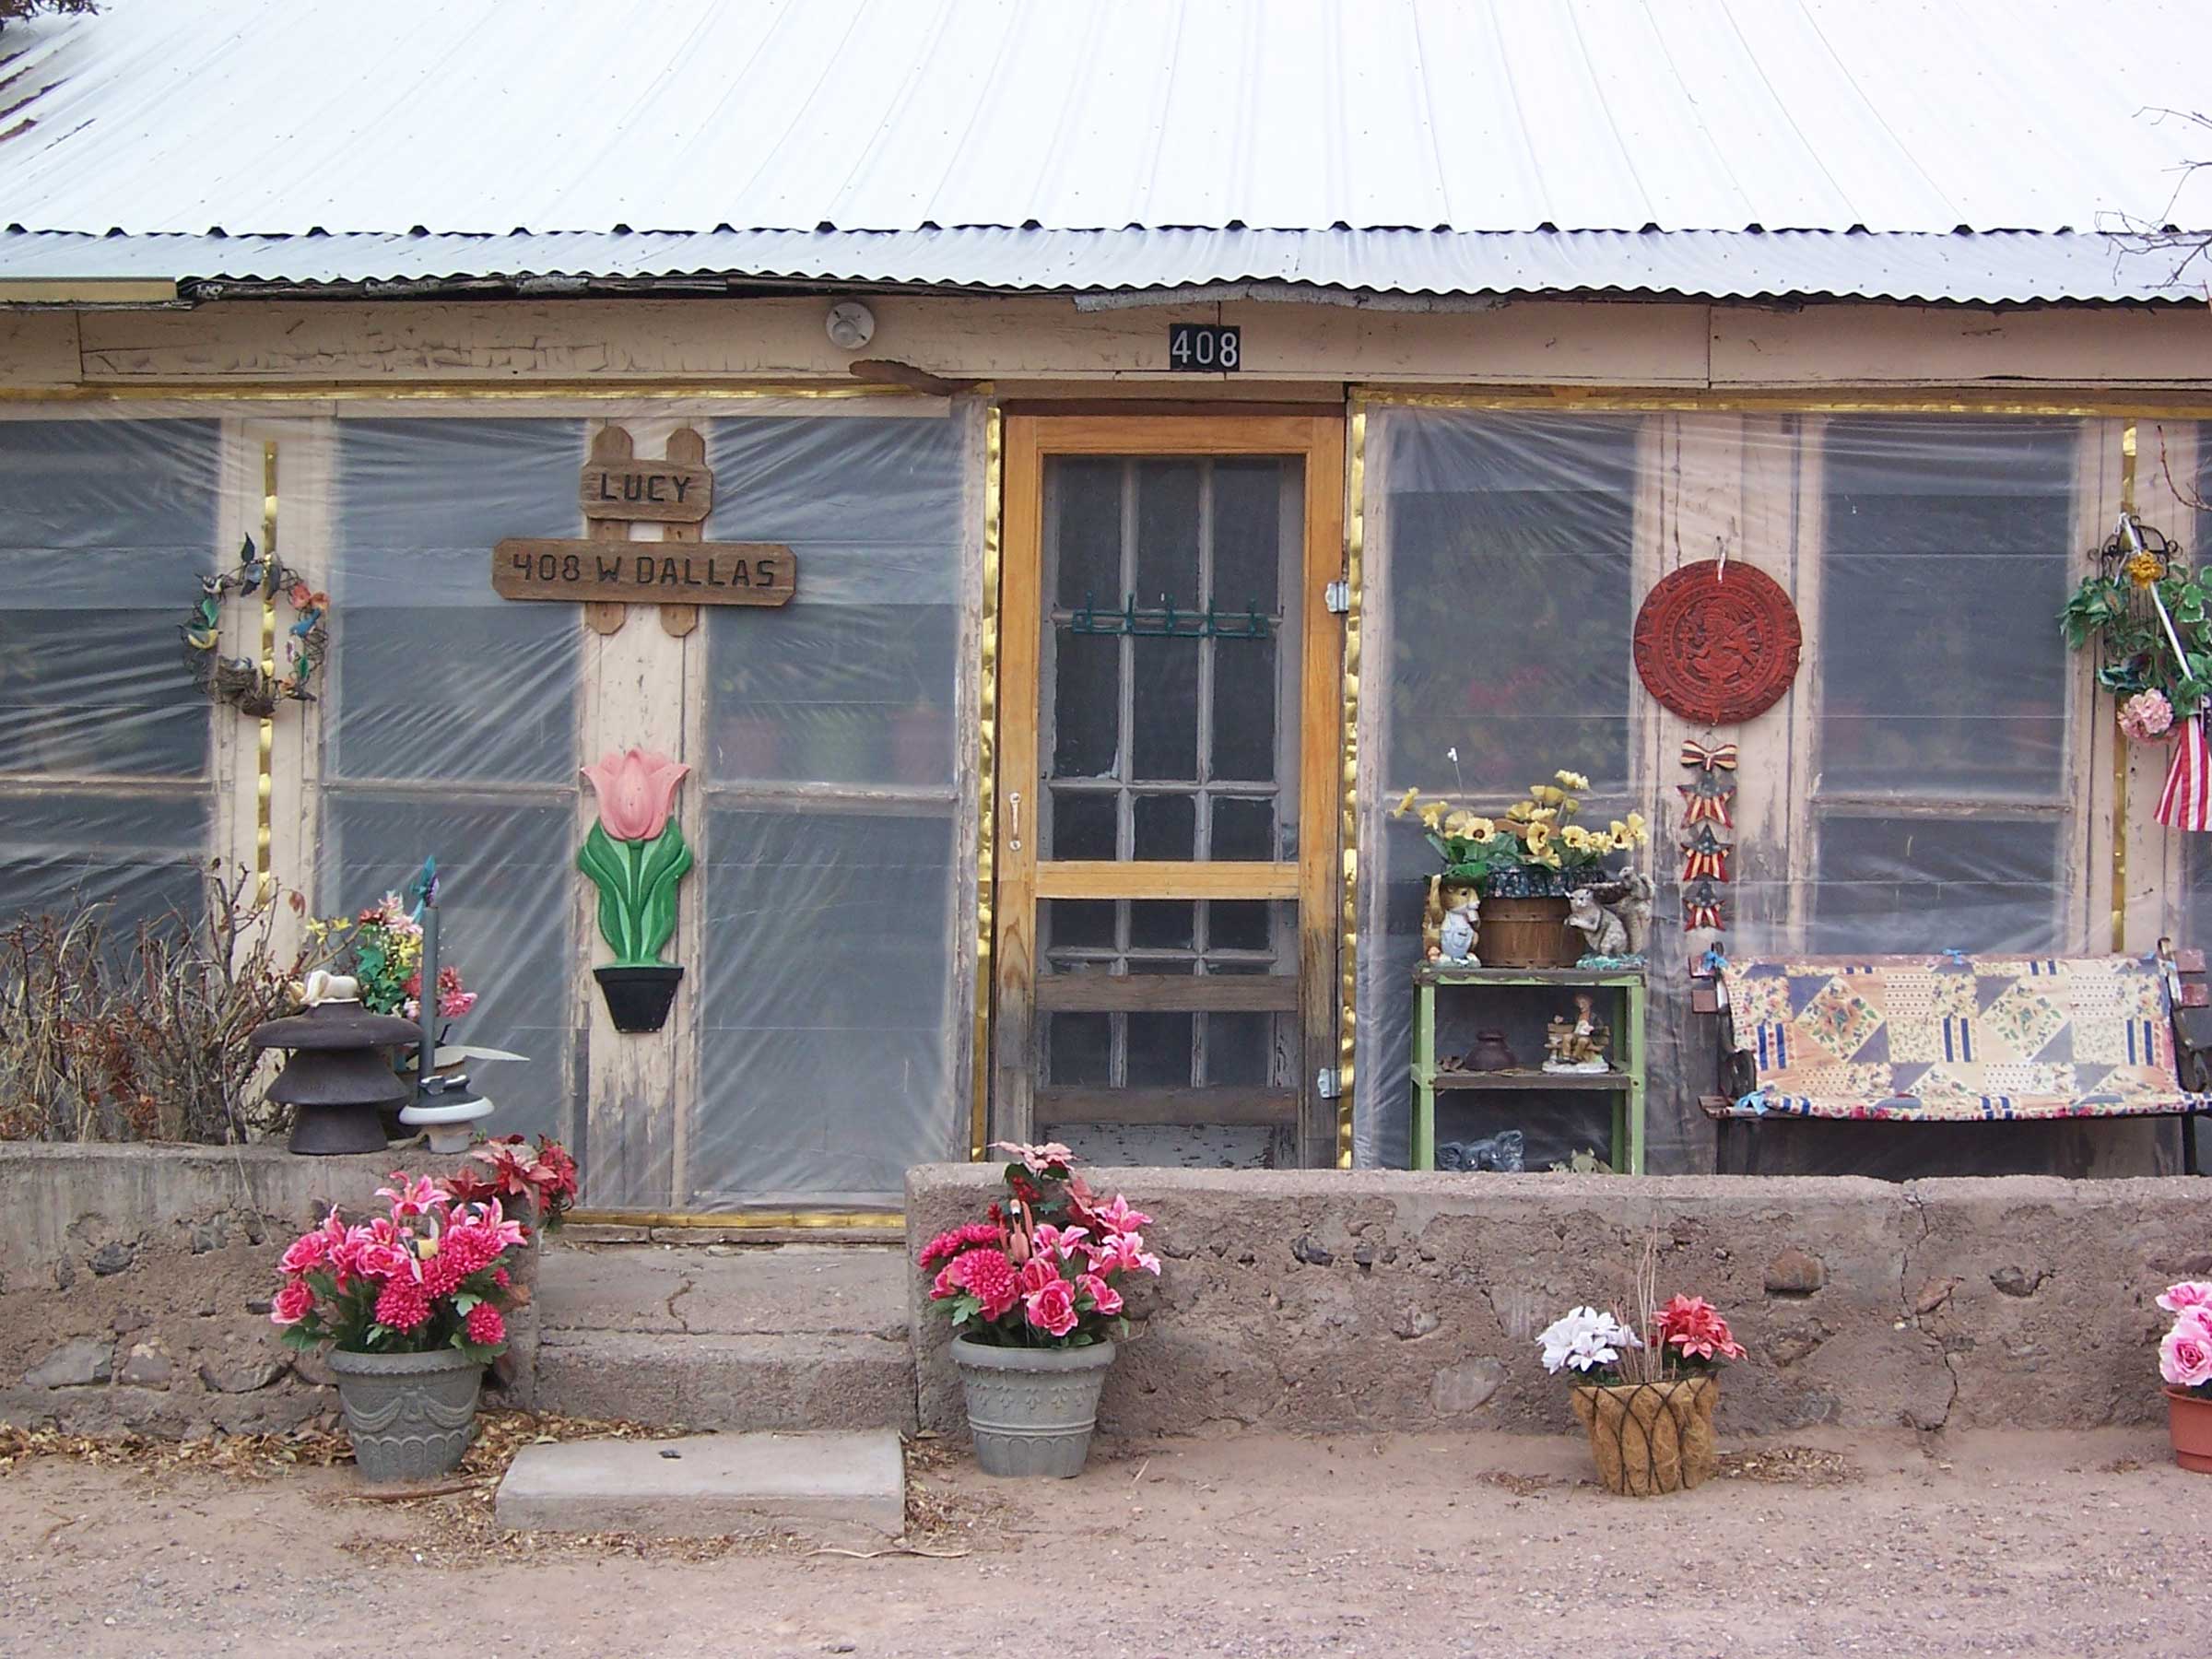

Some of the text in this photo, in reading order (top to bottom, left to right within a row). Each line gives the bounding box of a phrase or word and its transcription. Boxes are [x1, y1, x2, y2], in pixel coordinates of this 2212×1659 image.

[1171, 330, 1238, 368] 408
[600, 472, 691, 503] LUCY
[512, 553, 775, 587] 408 W DALLAS
